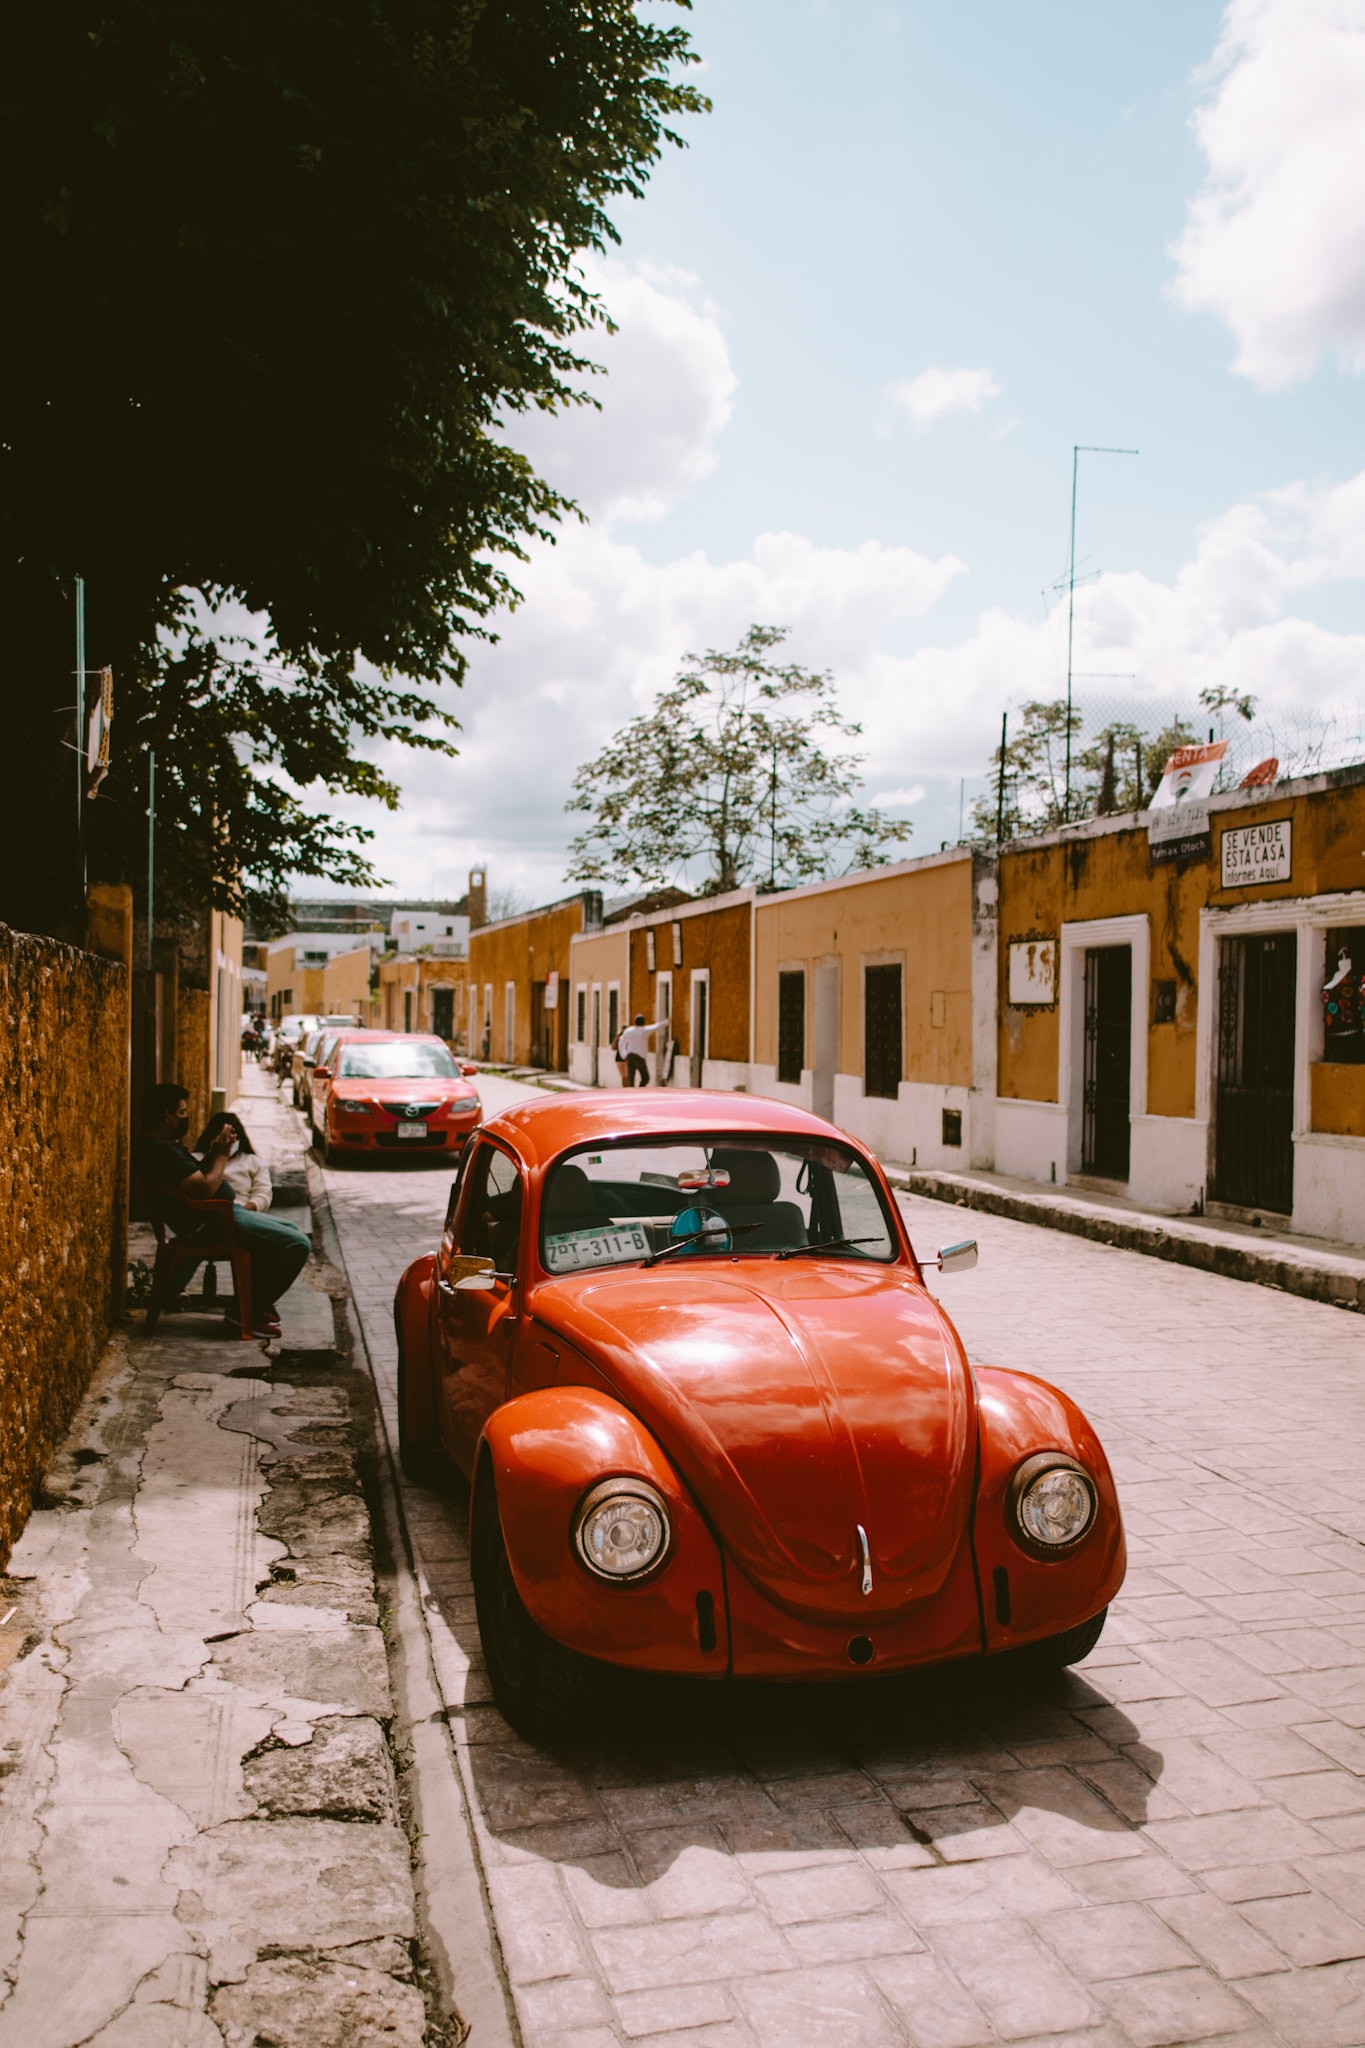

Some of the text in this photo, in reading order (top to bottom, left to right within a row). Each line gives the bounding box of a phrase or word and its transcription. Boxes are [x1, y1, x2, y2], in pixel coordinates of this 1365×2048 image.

[1172, 747, 1208, 765] ENTA
[1181, 839, 1206, 854] Otoch
[1226, 825, 1282, 850] SE VENDE
[1226, 843, 1285, 868] ESTA CASA
[1225, 868, 1256, 884] Informes
